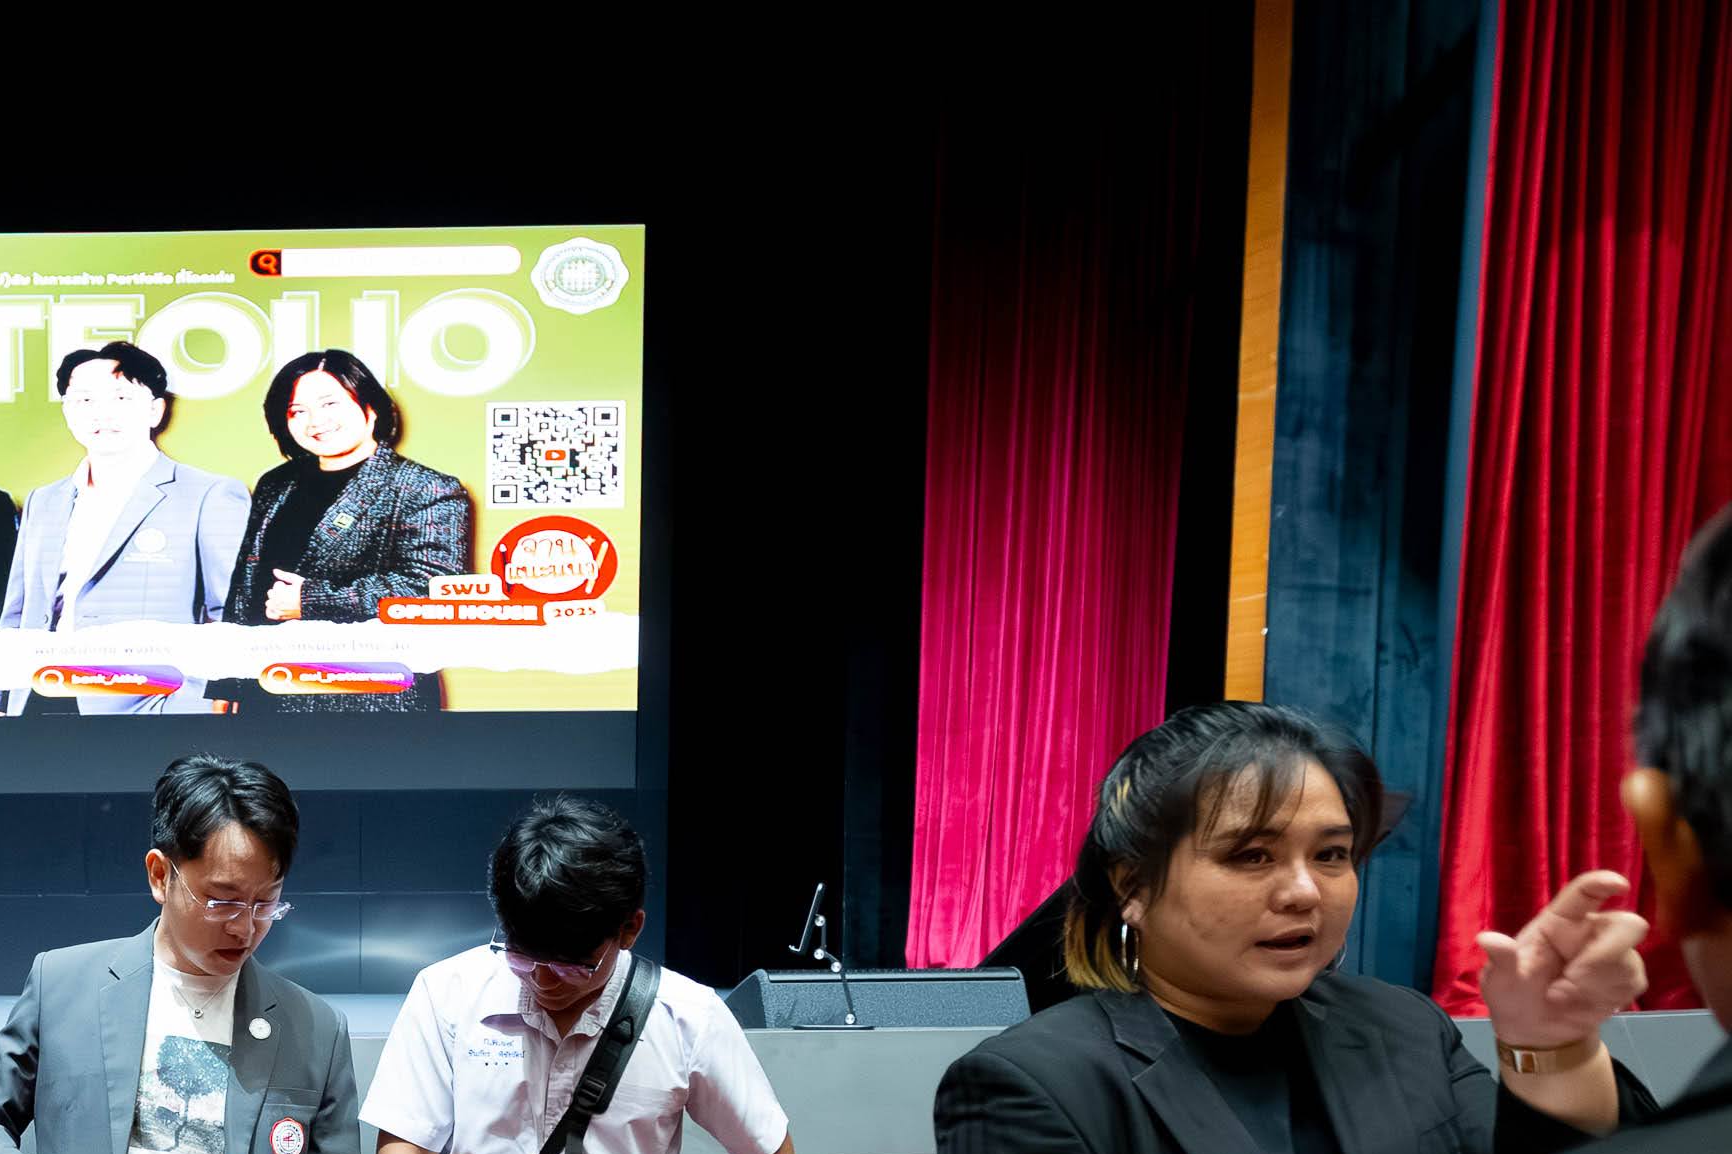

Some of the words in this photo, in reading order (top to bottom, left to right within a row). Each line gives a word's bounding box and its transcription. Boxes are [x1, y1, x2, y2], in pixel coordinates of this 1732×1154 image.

[440, 583, 491, 596] SWU
[387, 603, 455, 620] OPEN
[458, 604, 538, 621] HOUSE
[554, 607, 597, 619] 2025
